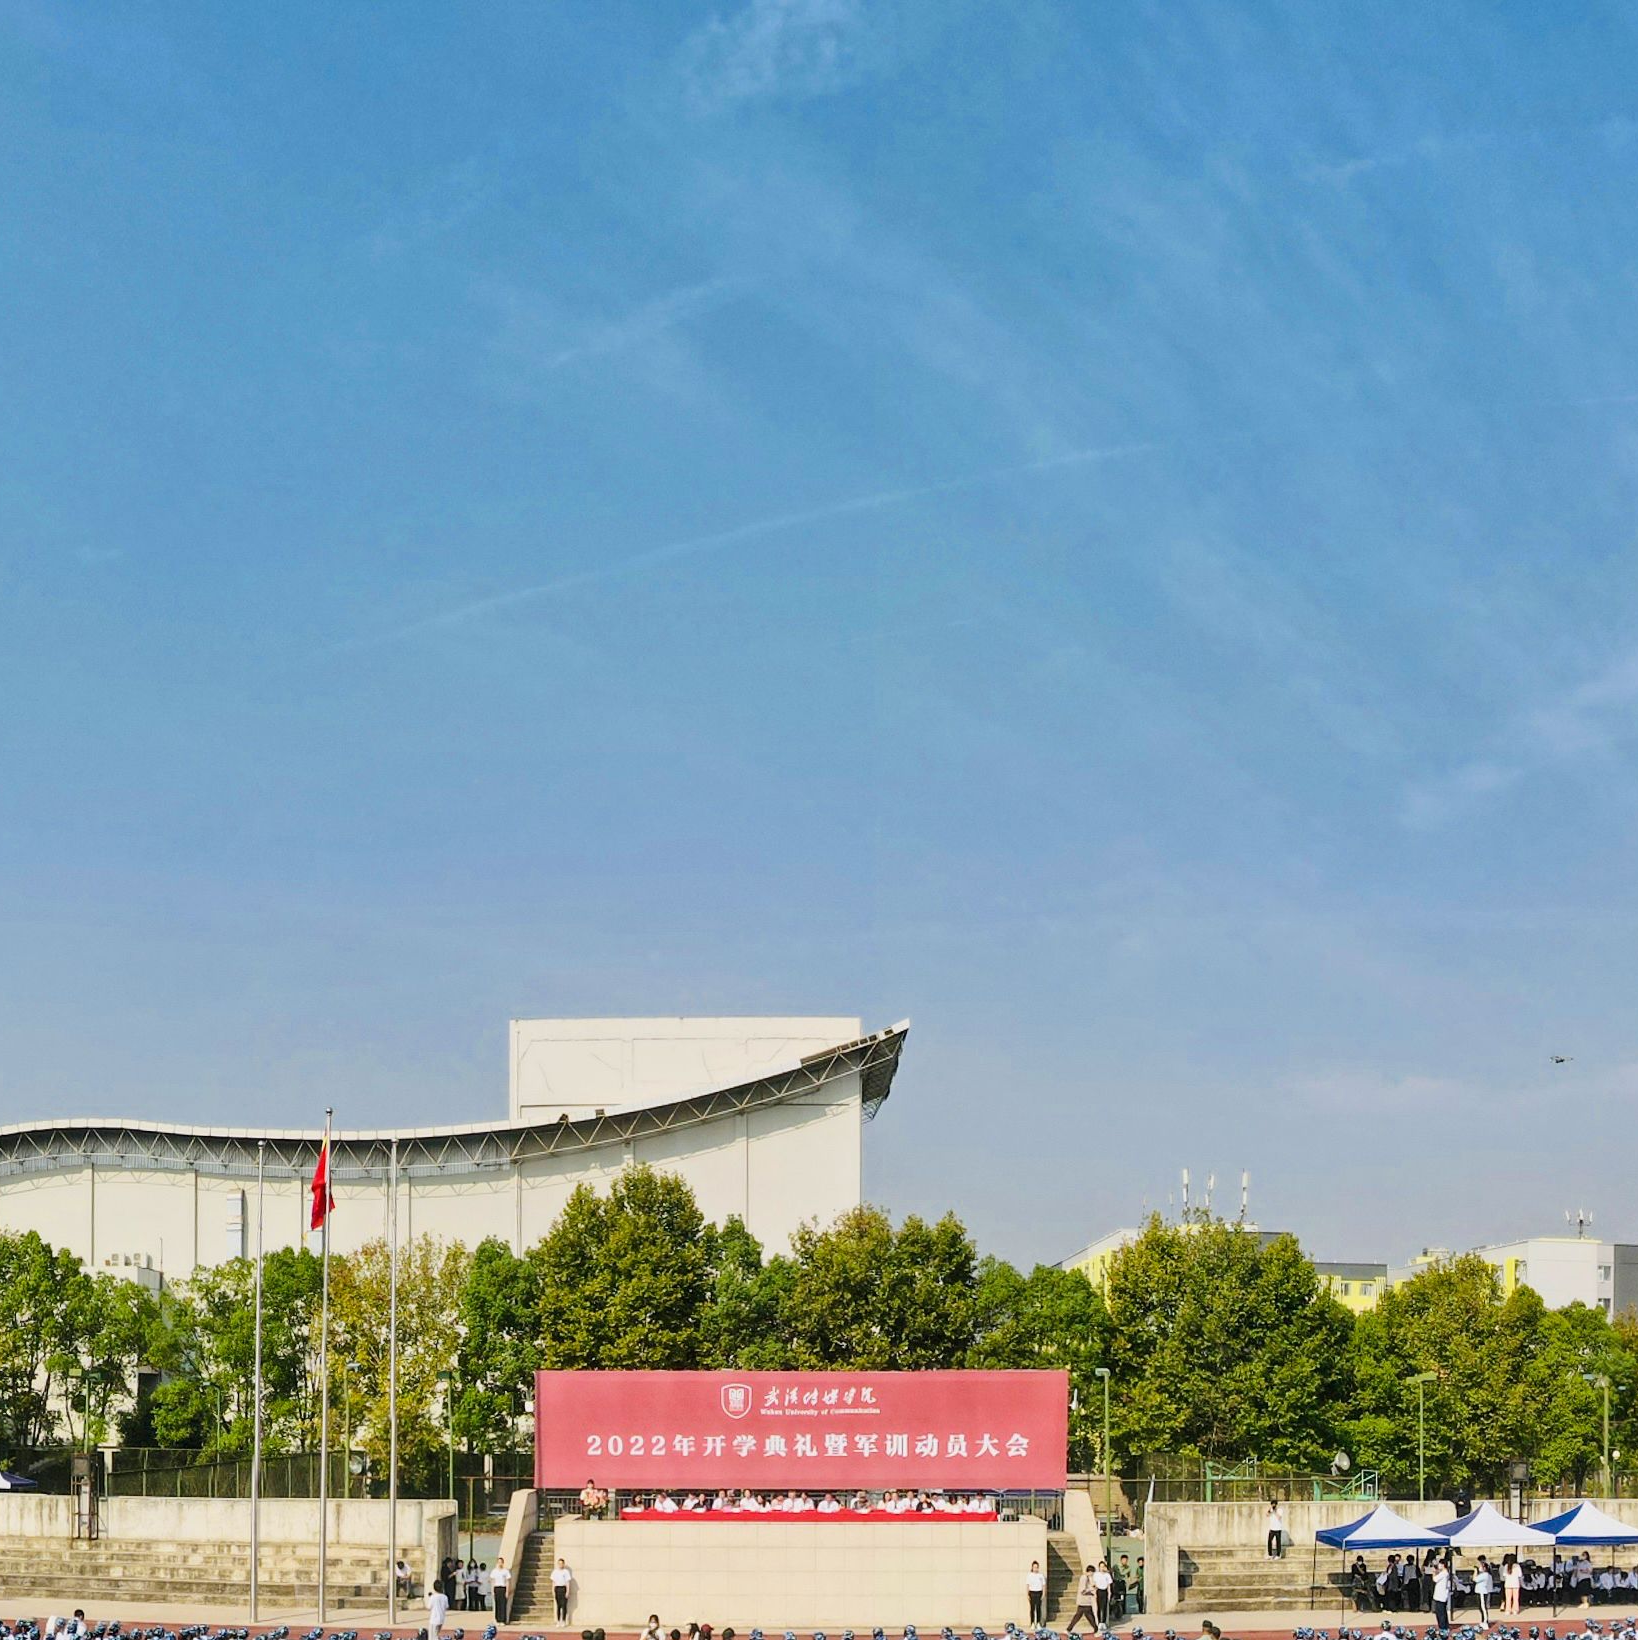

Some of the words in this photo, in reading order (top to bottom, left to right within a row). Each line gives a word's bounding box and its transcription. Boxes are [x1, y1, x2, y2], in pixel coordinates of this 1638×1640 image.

[760, 1408, 783, 1416] Wuhan
[785, 1408, 819, 1417] University
[821, 1408, 829, 1416] of
[586, 1433, 1029, 1458] 2022年开学典礼暨军训动员大会
